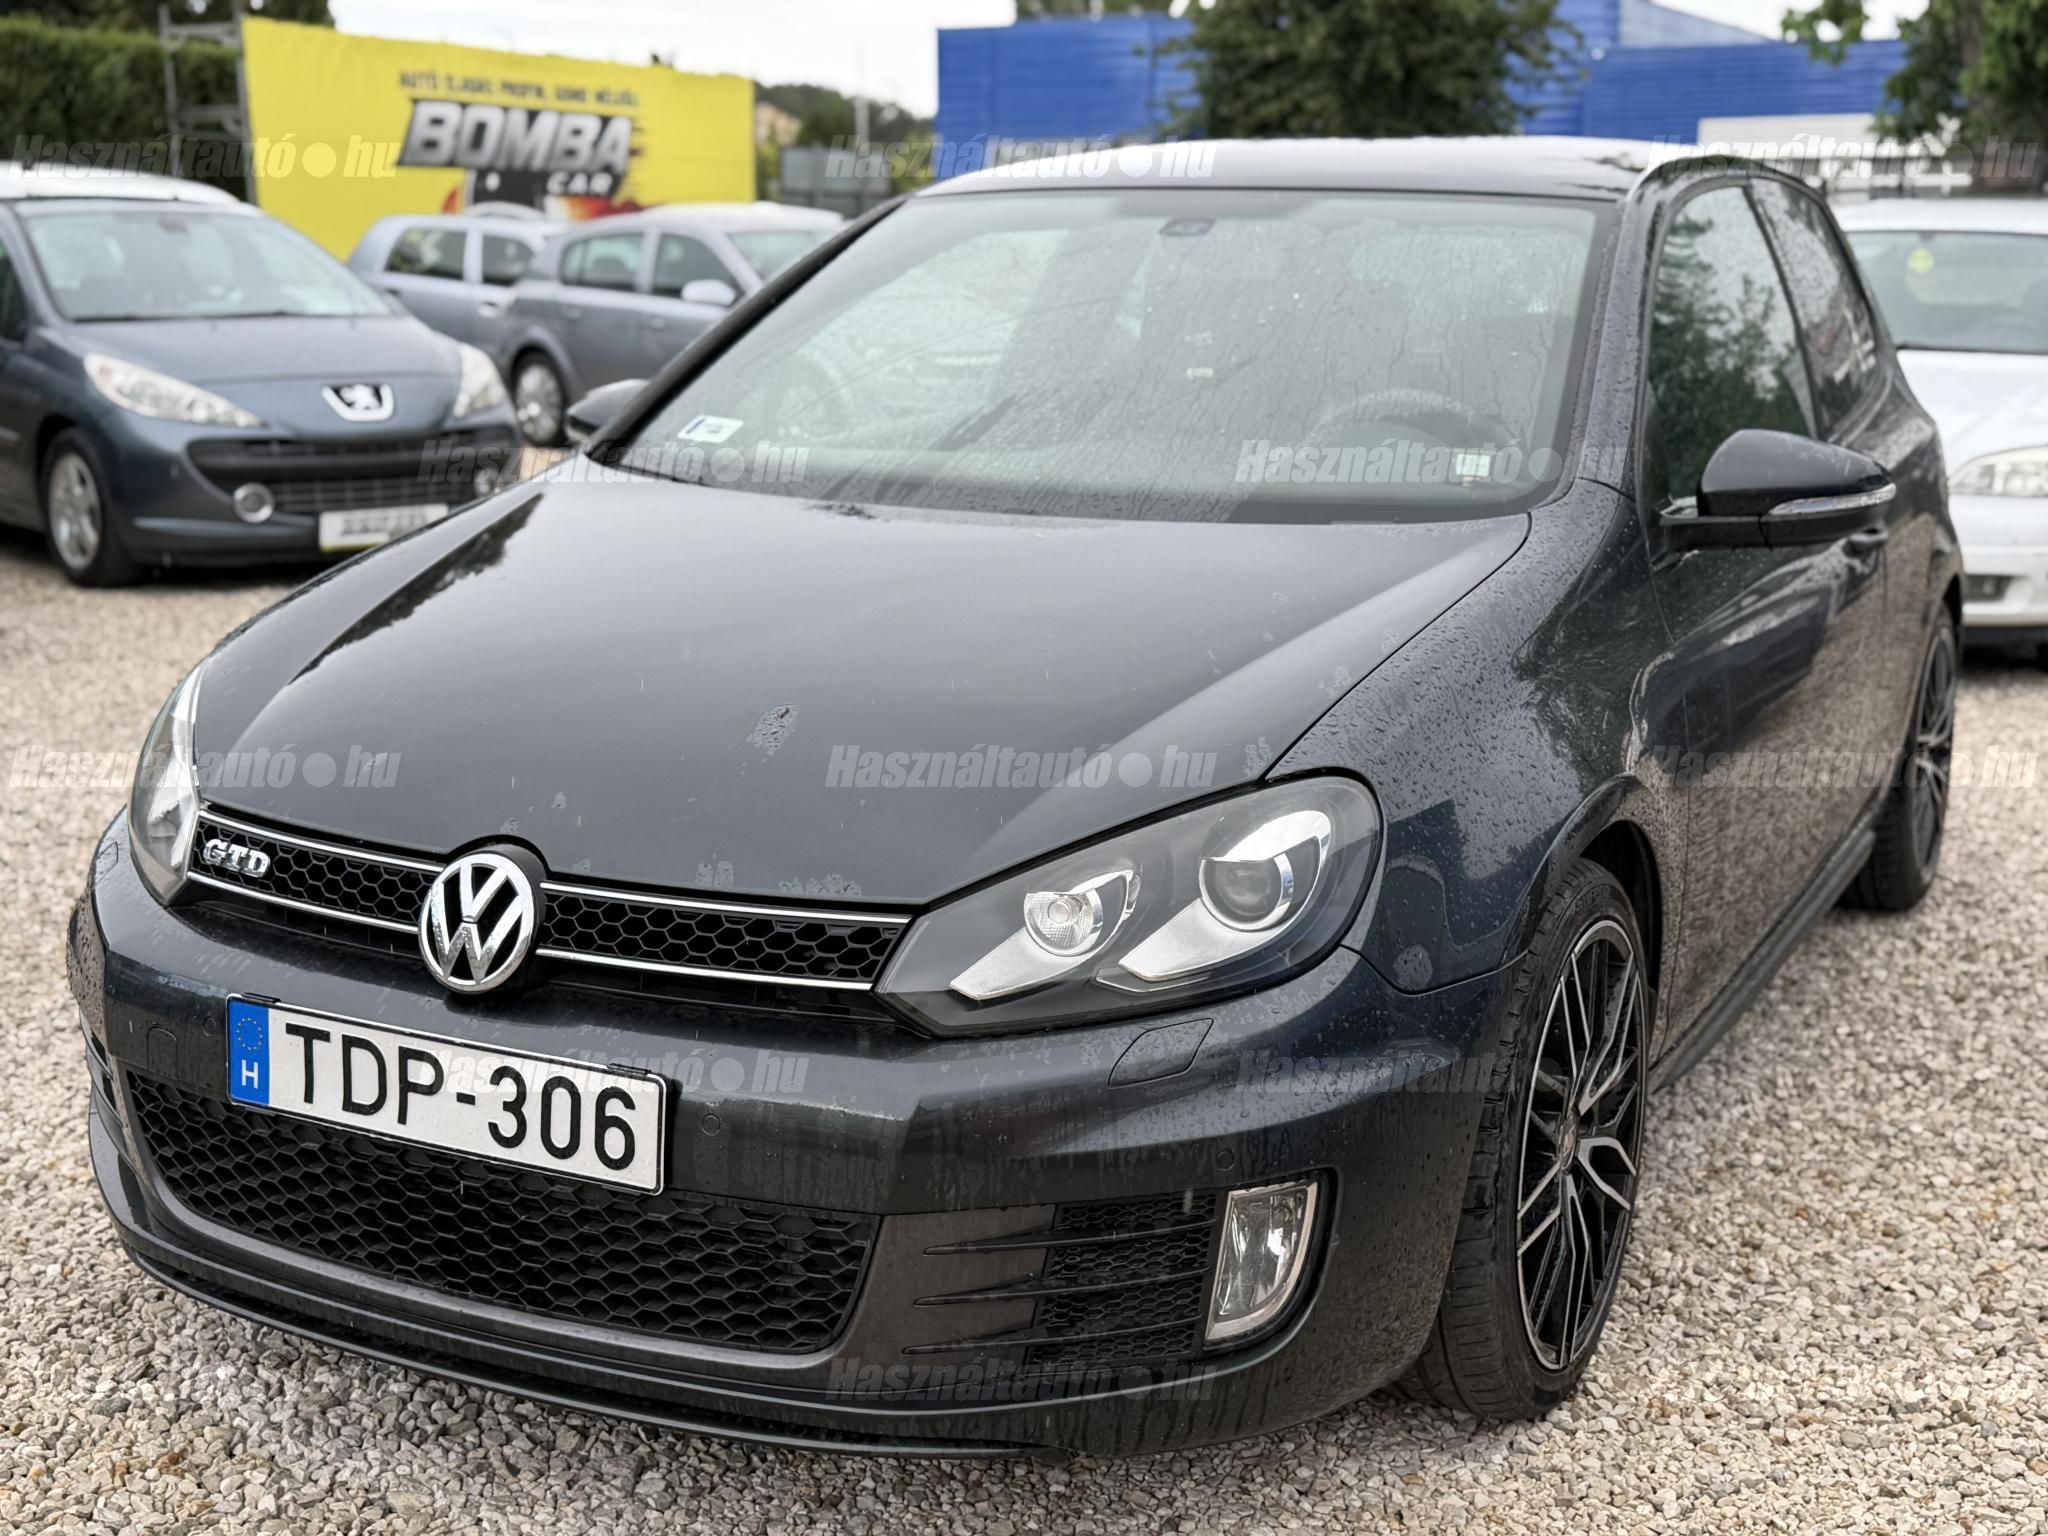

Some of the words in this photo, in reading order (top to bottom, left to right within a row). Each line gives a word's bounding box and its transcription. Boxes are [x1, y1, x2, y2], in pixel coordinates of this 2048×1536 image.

[400, 99, 632, 175] BOMBA
[547, 170, 613, 195] CAR
[203, 838, 271, 878] GTD
[241, 1059, 259, 1089] H
[285, 1022, 637, 1171] TDP-306
